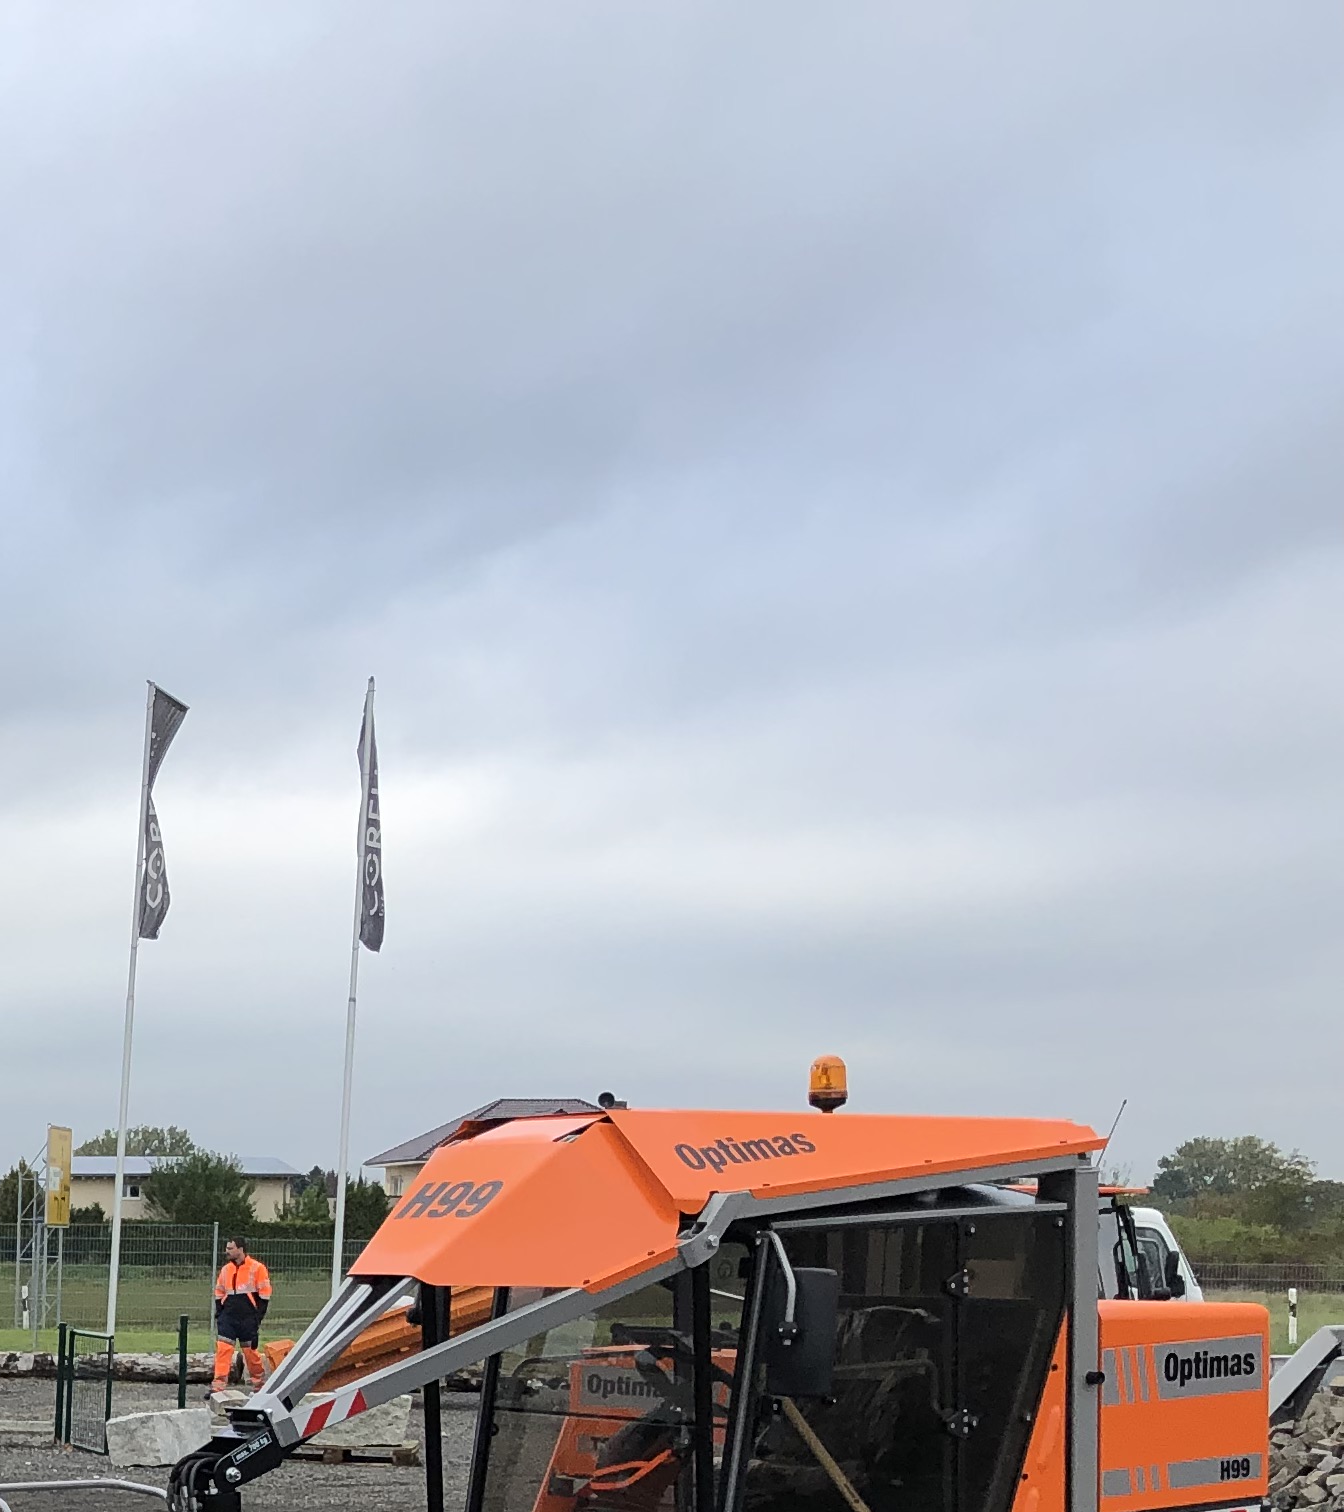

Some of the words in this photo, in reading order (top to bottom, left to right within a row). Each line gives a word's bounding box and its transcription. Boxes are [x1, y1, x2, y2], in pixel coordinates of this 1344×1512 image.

[674, 1133, 816, 1173] Optimas
[394, 1181, 504, 1219] H99
[1164, 1351, 1256, 1387] Optimas
[1220, 1458, 1250, 1480] H99
